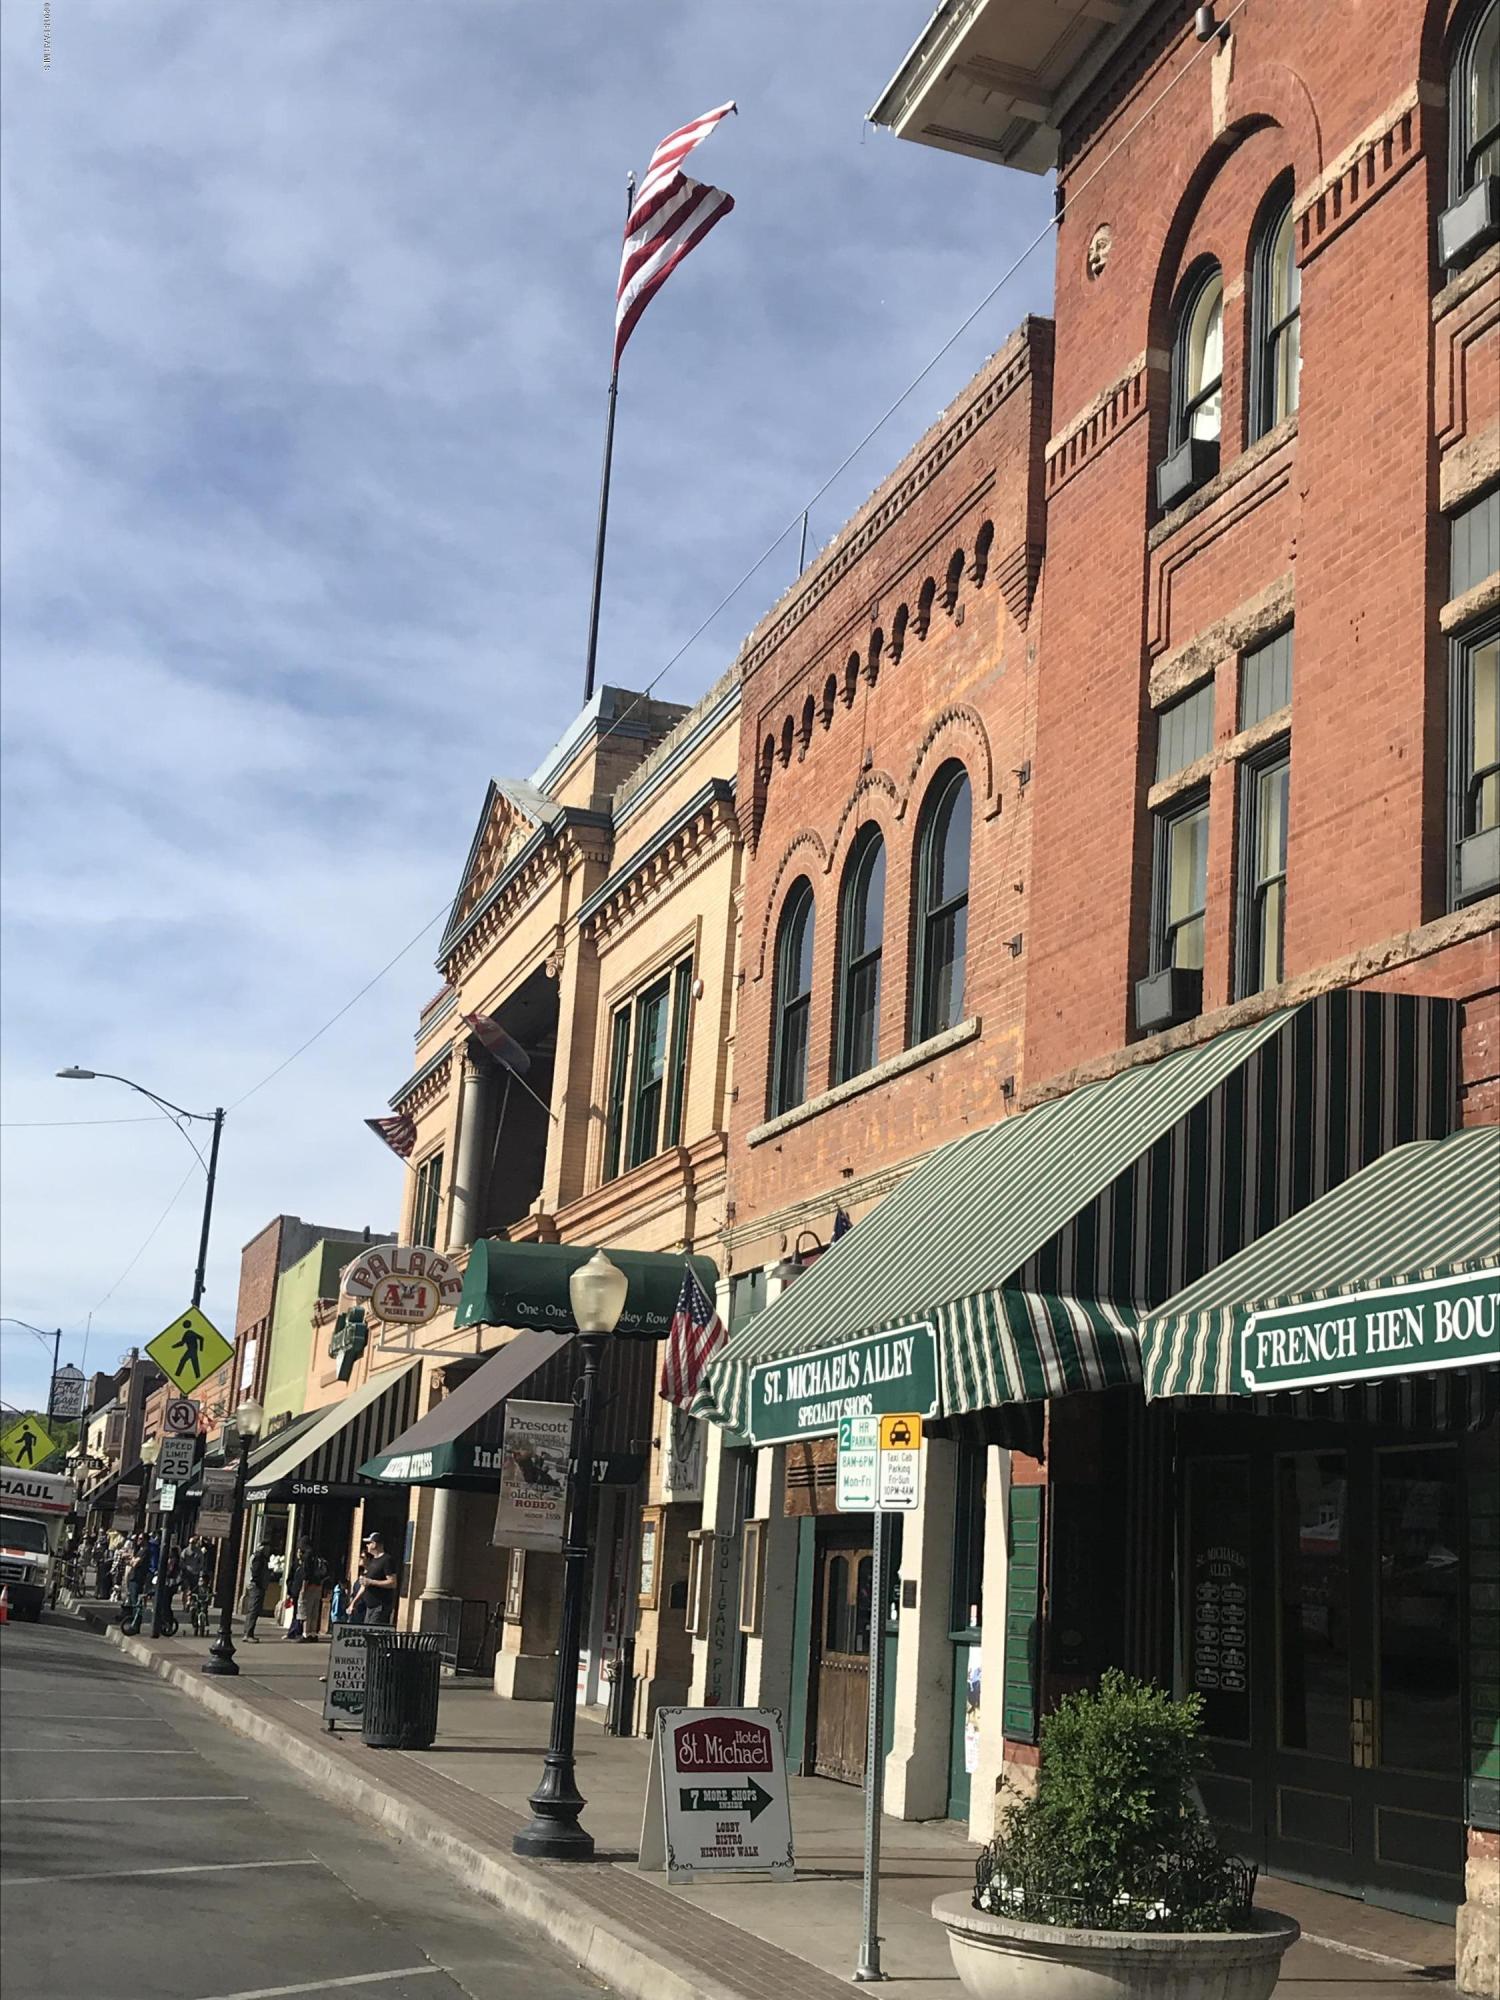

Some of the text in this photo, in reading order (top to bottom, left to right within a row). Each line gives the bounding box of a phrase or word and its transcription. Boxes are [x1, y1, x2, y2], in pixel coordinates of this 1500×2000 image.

[351, 1249, 463, 1297] PALACE
[620, 1310, 642, 1327] skey
[646, 1311, 669, 1324] Row
[1255, 1292, 1500, 1369] FRENCH HEN BOU
[763, 1336, 915, 1405] ST. MICHAEL'S ALLEY
[798, 1393, 873, 1427] SPECIALTY SHOPS
[509, 1417, 569, 1433] Prescott
[840, 1422, 869, 1447] 2 HR
[852, 1435, 876, 1447] PARKING
[164, 1442, 193, 1451] SPEED
[166, 1451, 188, 1459] LIMIT
[887, 1453, 913, 1462] Taxi Cab
[162, 1459, 189, 1476] 25
[888, 1464, 911, 1474] Parking
[510, 1488, 544, 1500] oldest
[514, 1499, 556, 1510] RODEO
[735, 1730, 762, 1744] Hotel
[704, 1733, 769, 1764] Michael
[690, 1789, 757, 1809] 7 MORE SHOPS
[719, 1801, 743, 1809] INSIDE
[716, 1822, 740, 1833] LOBBY
[715, 1834, 743, 1845] BISTRO
[700, 1846, 759, 1858] HISTORIC WALK
